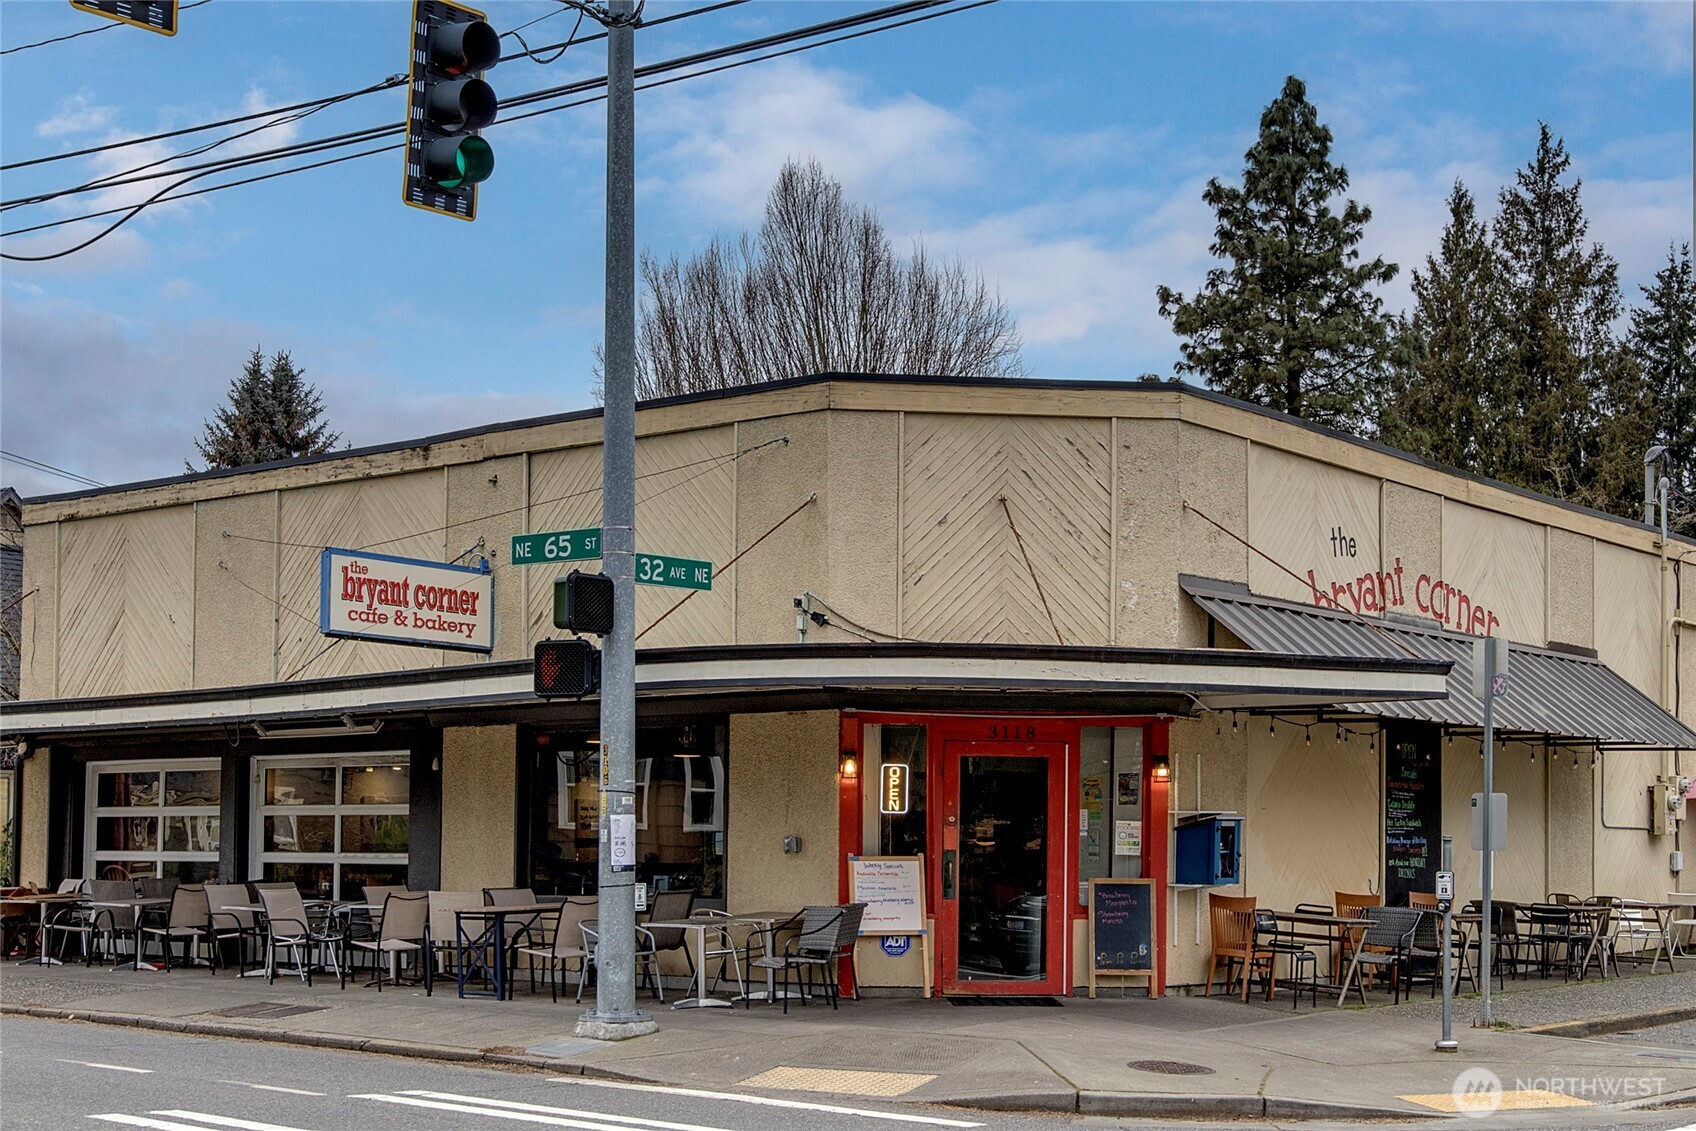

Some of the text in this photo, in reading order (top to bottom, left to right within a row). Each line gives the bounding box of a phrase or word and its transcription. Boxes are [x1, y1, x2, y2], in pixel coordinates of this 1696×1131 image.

[516, 534, 597, 558] NE 65 ST
[1330, 526, 1357, 558] the
[350, 561, 369, 575] the
[639, 557, 709, 584] 32 AVE NE
[341, 566, 479, 617] bryant corner
[1415, 573, 1500, 638] corner
[348, 607, 477, 639] cafe & bakery
[988, 725, 1036, 740] 3118
[888, 766, 901, 811] OPEN
[885, 936, 906, 947] ADT
